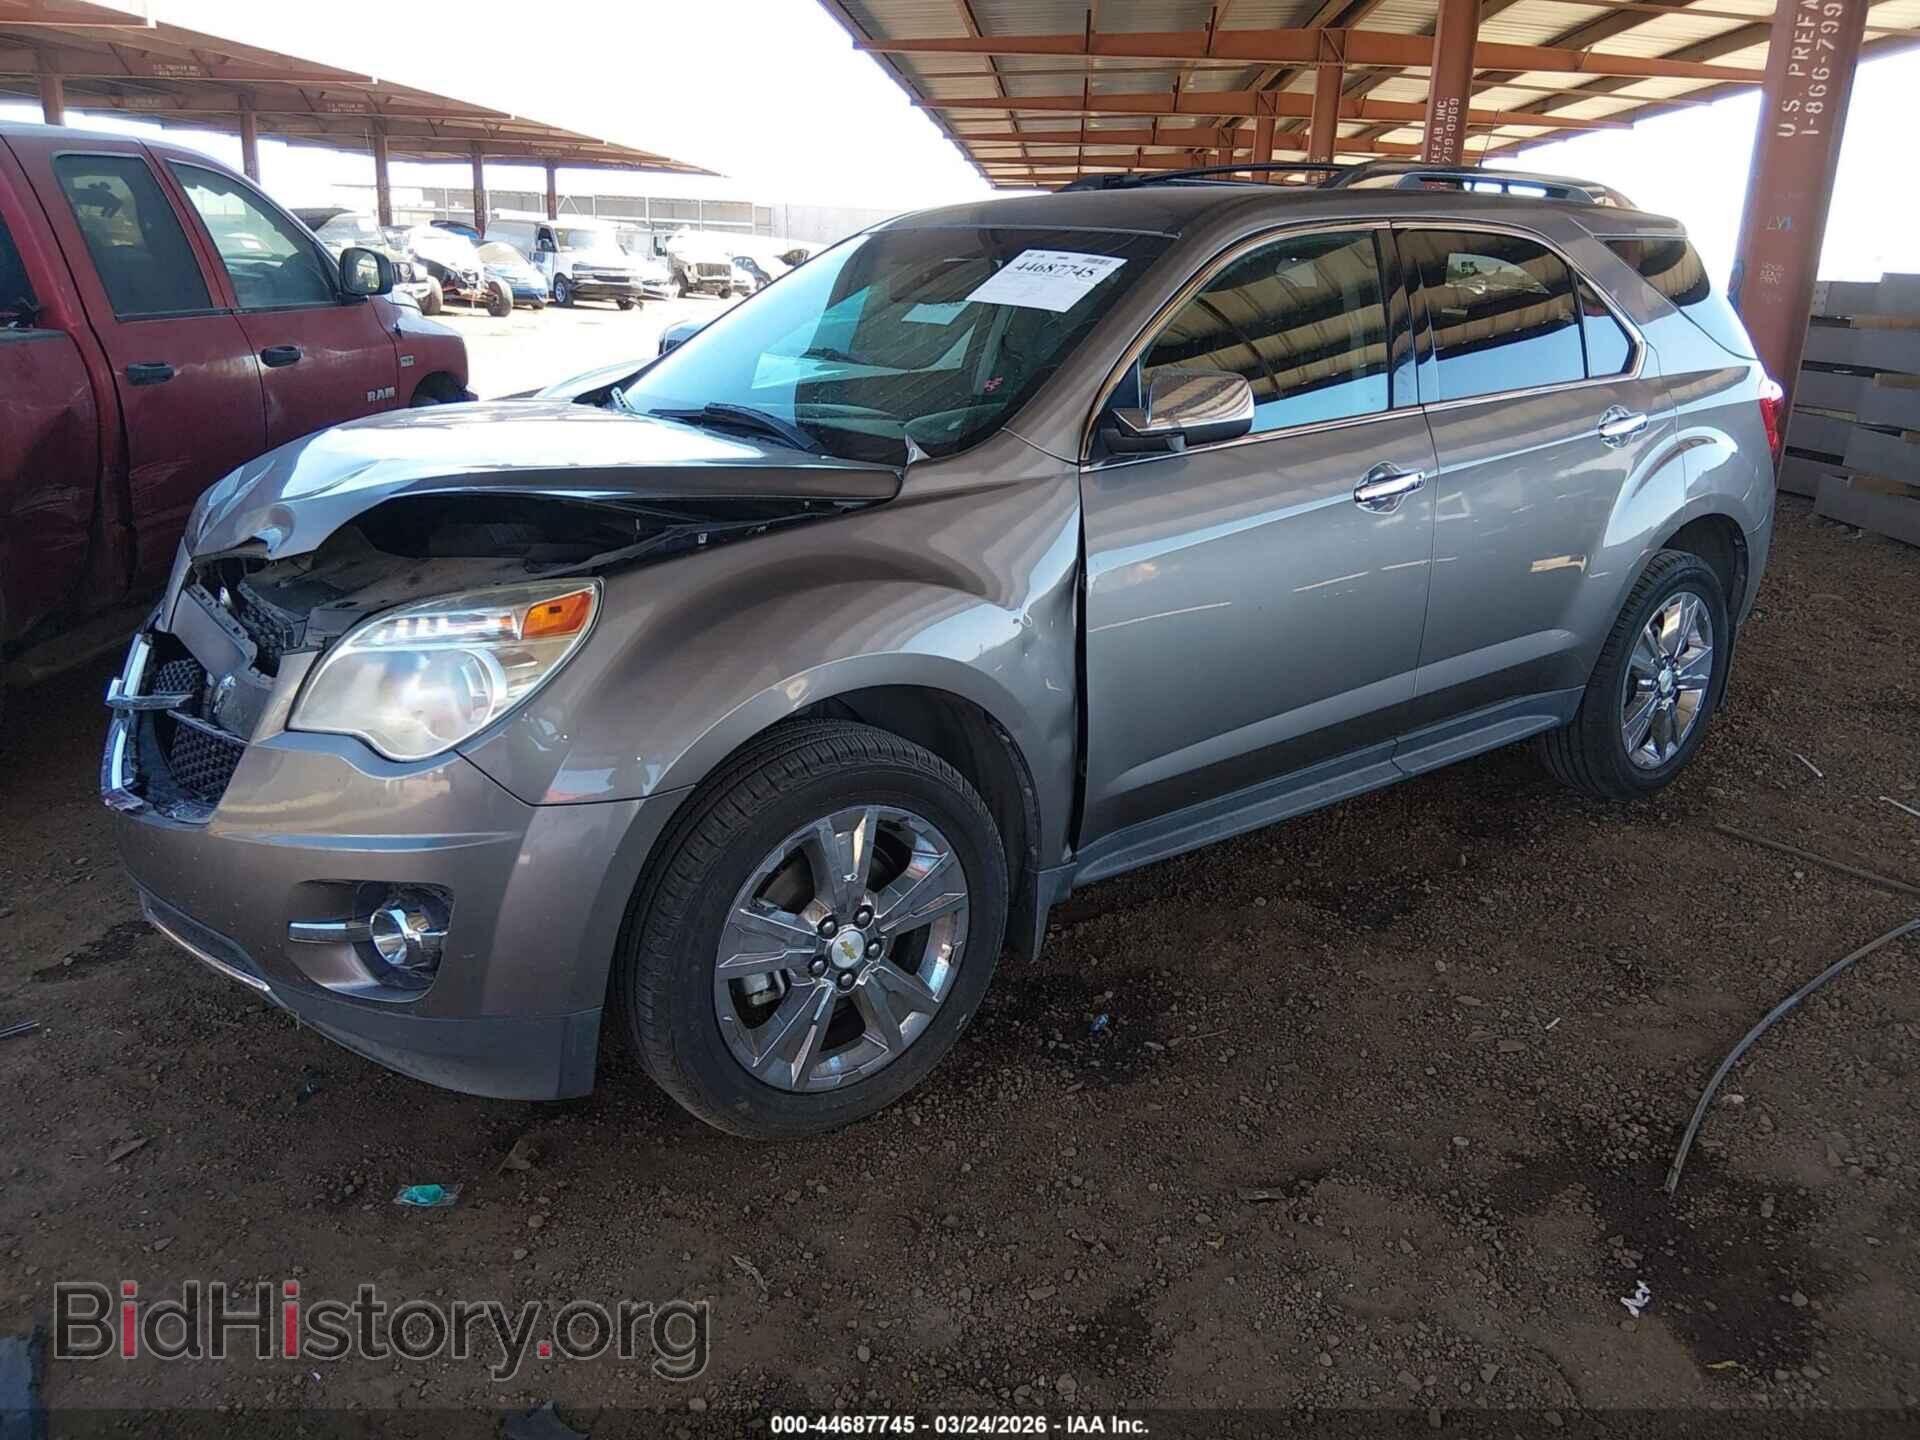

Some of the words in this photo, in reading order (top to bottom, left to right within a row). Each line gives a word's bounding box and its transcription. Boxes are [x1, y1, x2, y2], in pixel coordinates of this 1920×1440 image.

[1801, 2, 1843, 134] 1-866-799
[1776, 92, 1802, 137] U.S.
[1015, 262, 1097, 278] 44687745
[367, 387, 395, 402] RAM
